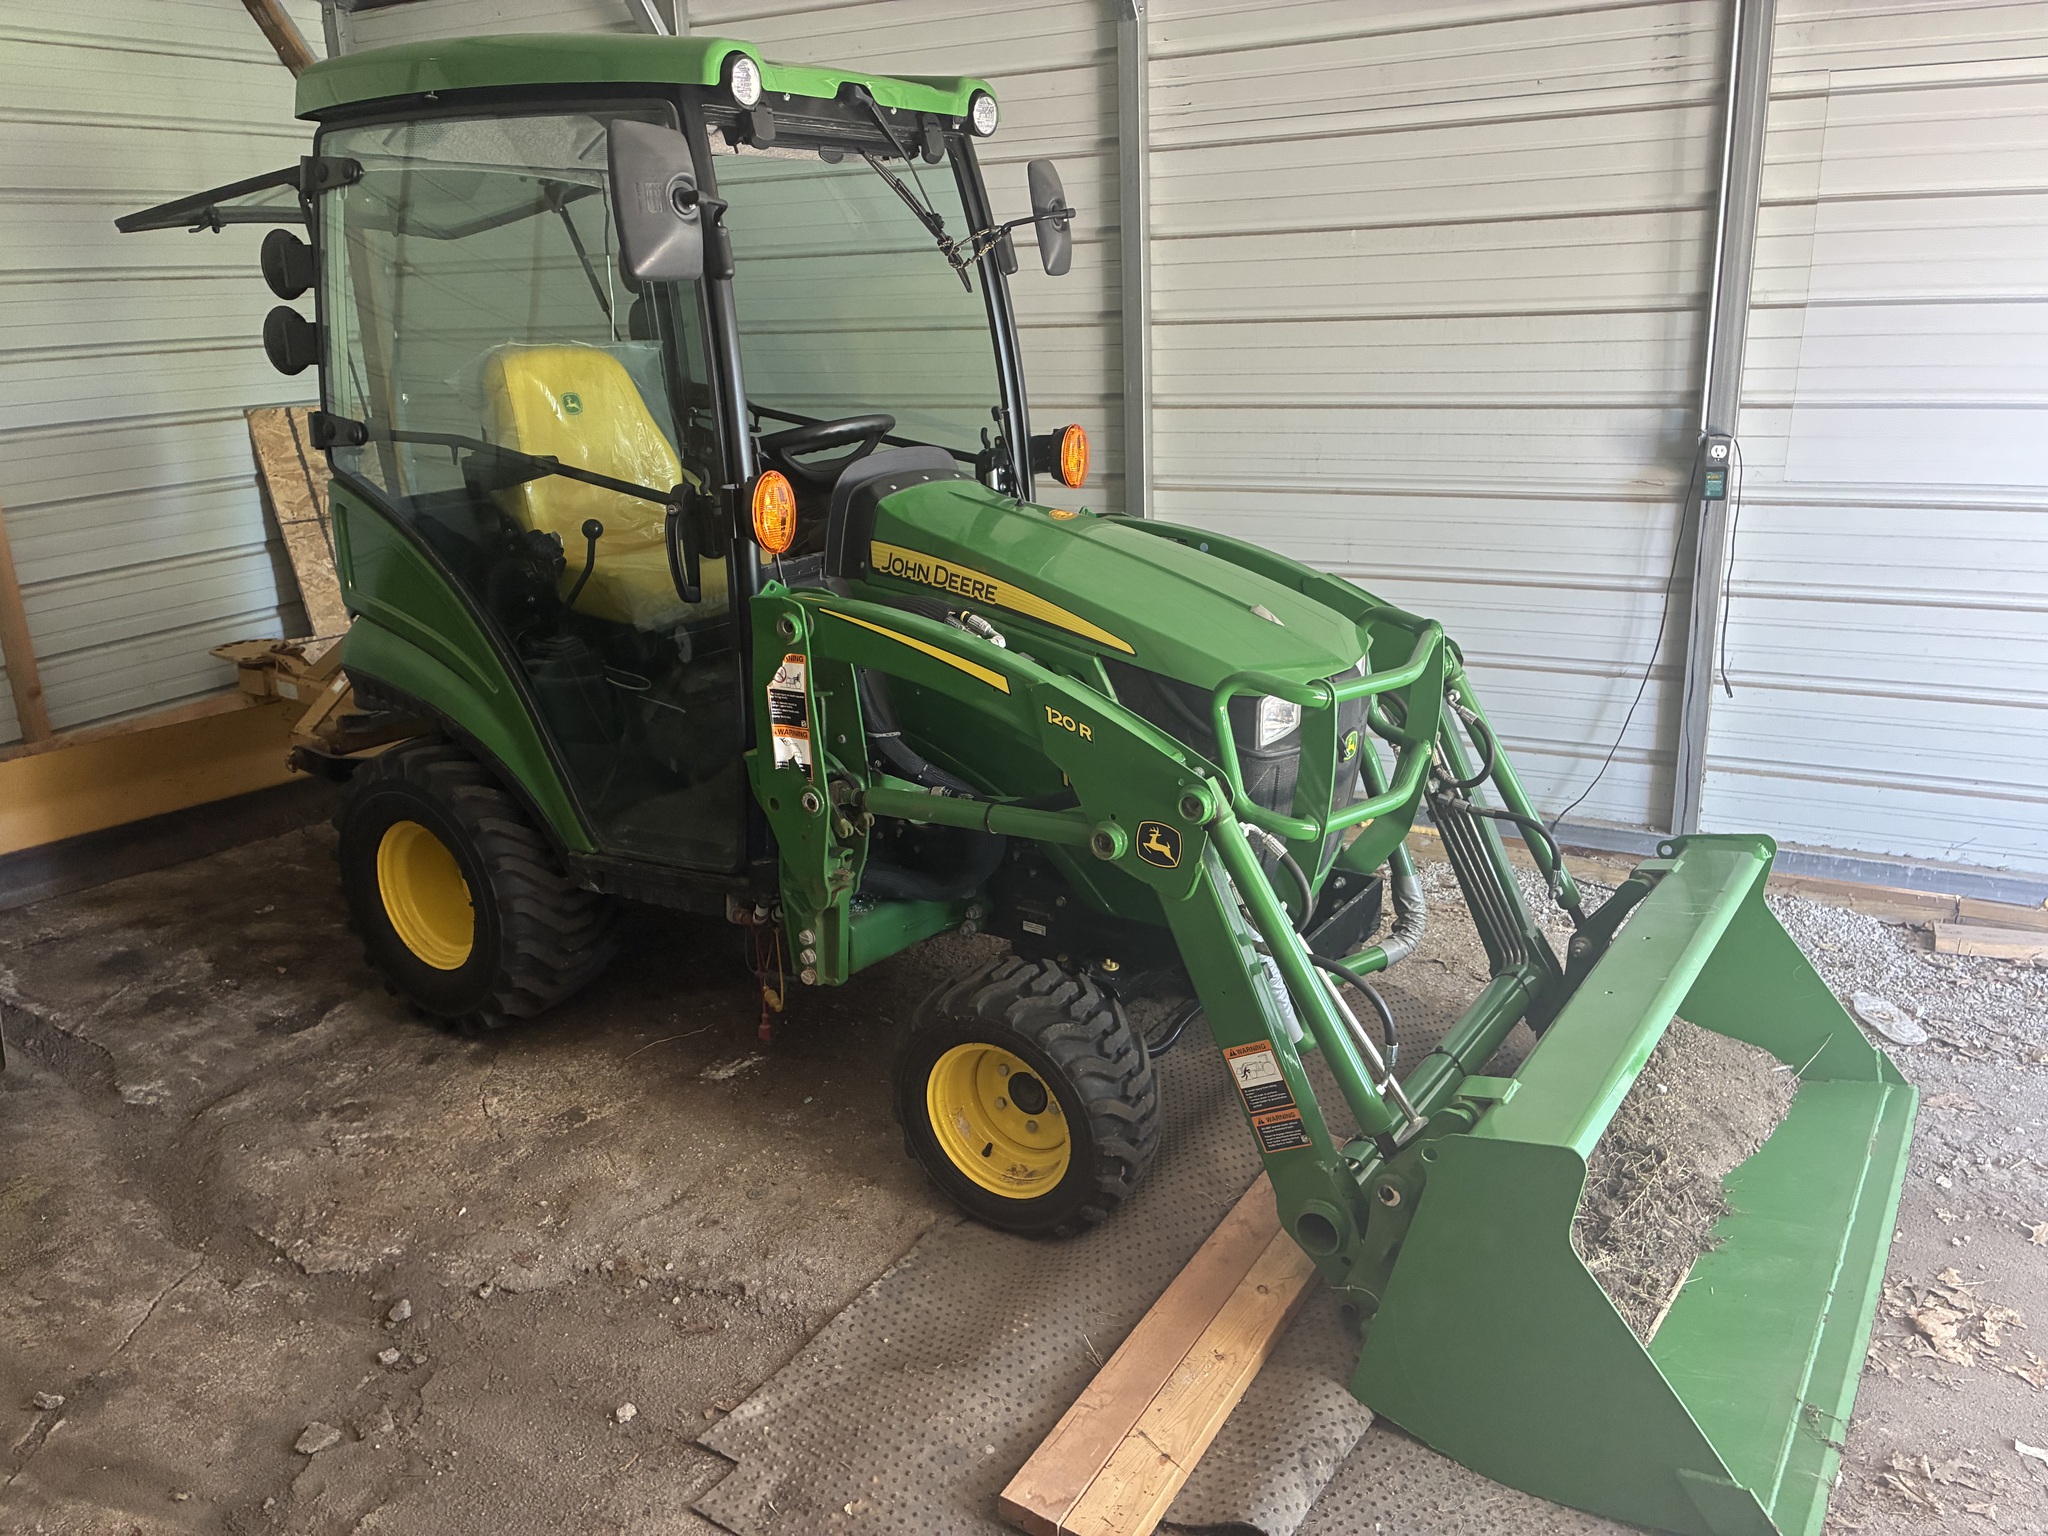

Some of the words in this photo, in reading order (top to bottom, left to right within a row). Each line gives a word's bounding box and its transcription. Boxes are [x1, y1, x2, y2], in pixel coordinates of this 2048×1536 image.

[881, 552, 930, 582] JOHN
[933, 564, 998, 603] DEERE
[1045, 705, 1077, 732] 120
[777, 728, 808, 739] WARNING
[1236, 1043, 1267, 1055] WARNING
[1265, 1111, 1296, 1123] WARNING
